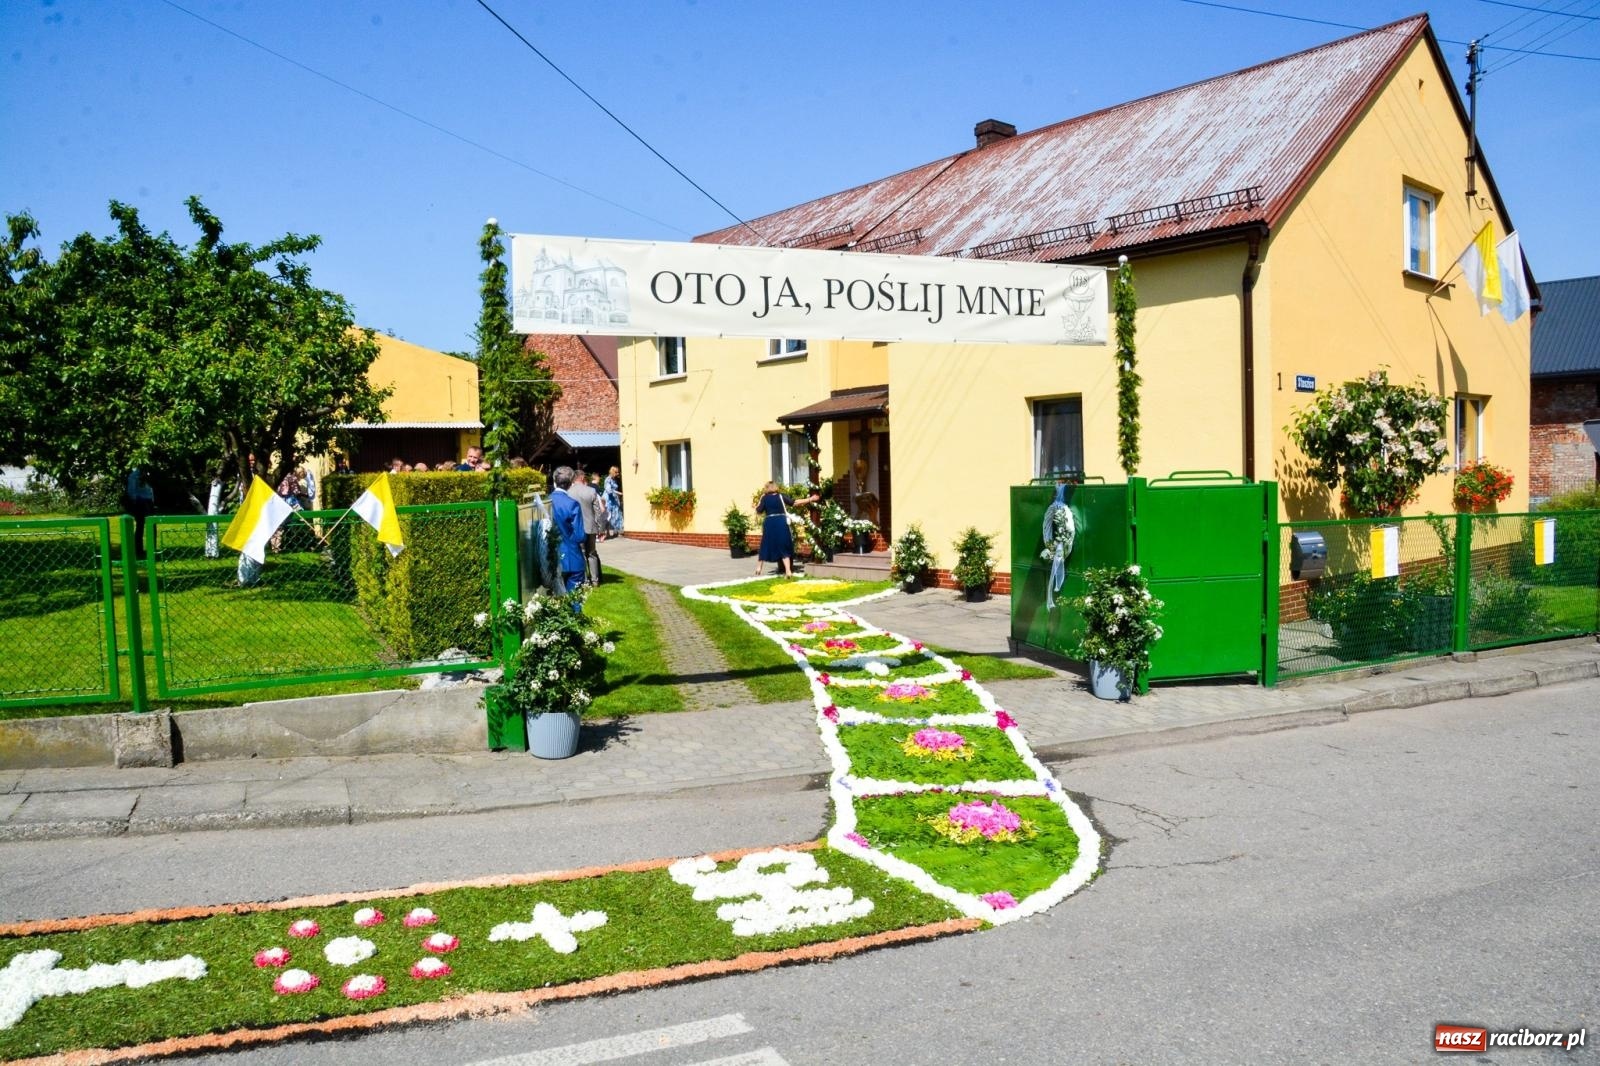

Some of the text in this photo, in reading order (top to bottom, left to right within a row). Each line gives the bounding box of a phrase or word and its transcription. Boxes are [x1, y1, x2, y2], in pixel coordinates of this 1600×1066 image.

[650, 270, 1046, 324] OTO JA, POŚLIJ MNIE
[1277, 373, 1282, 391] 1
